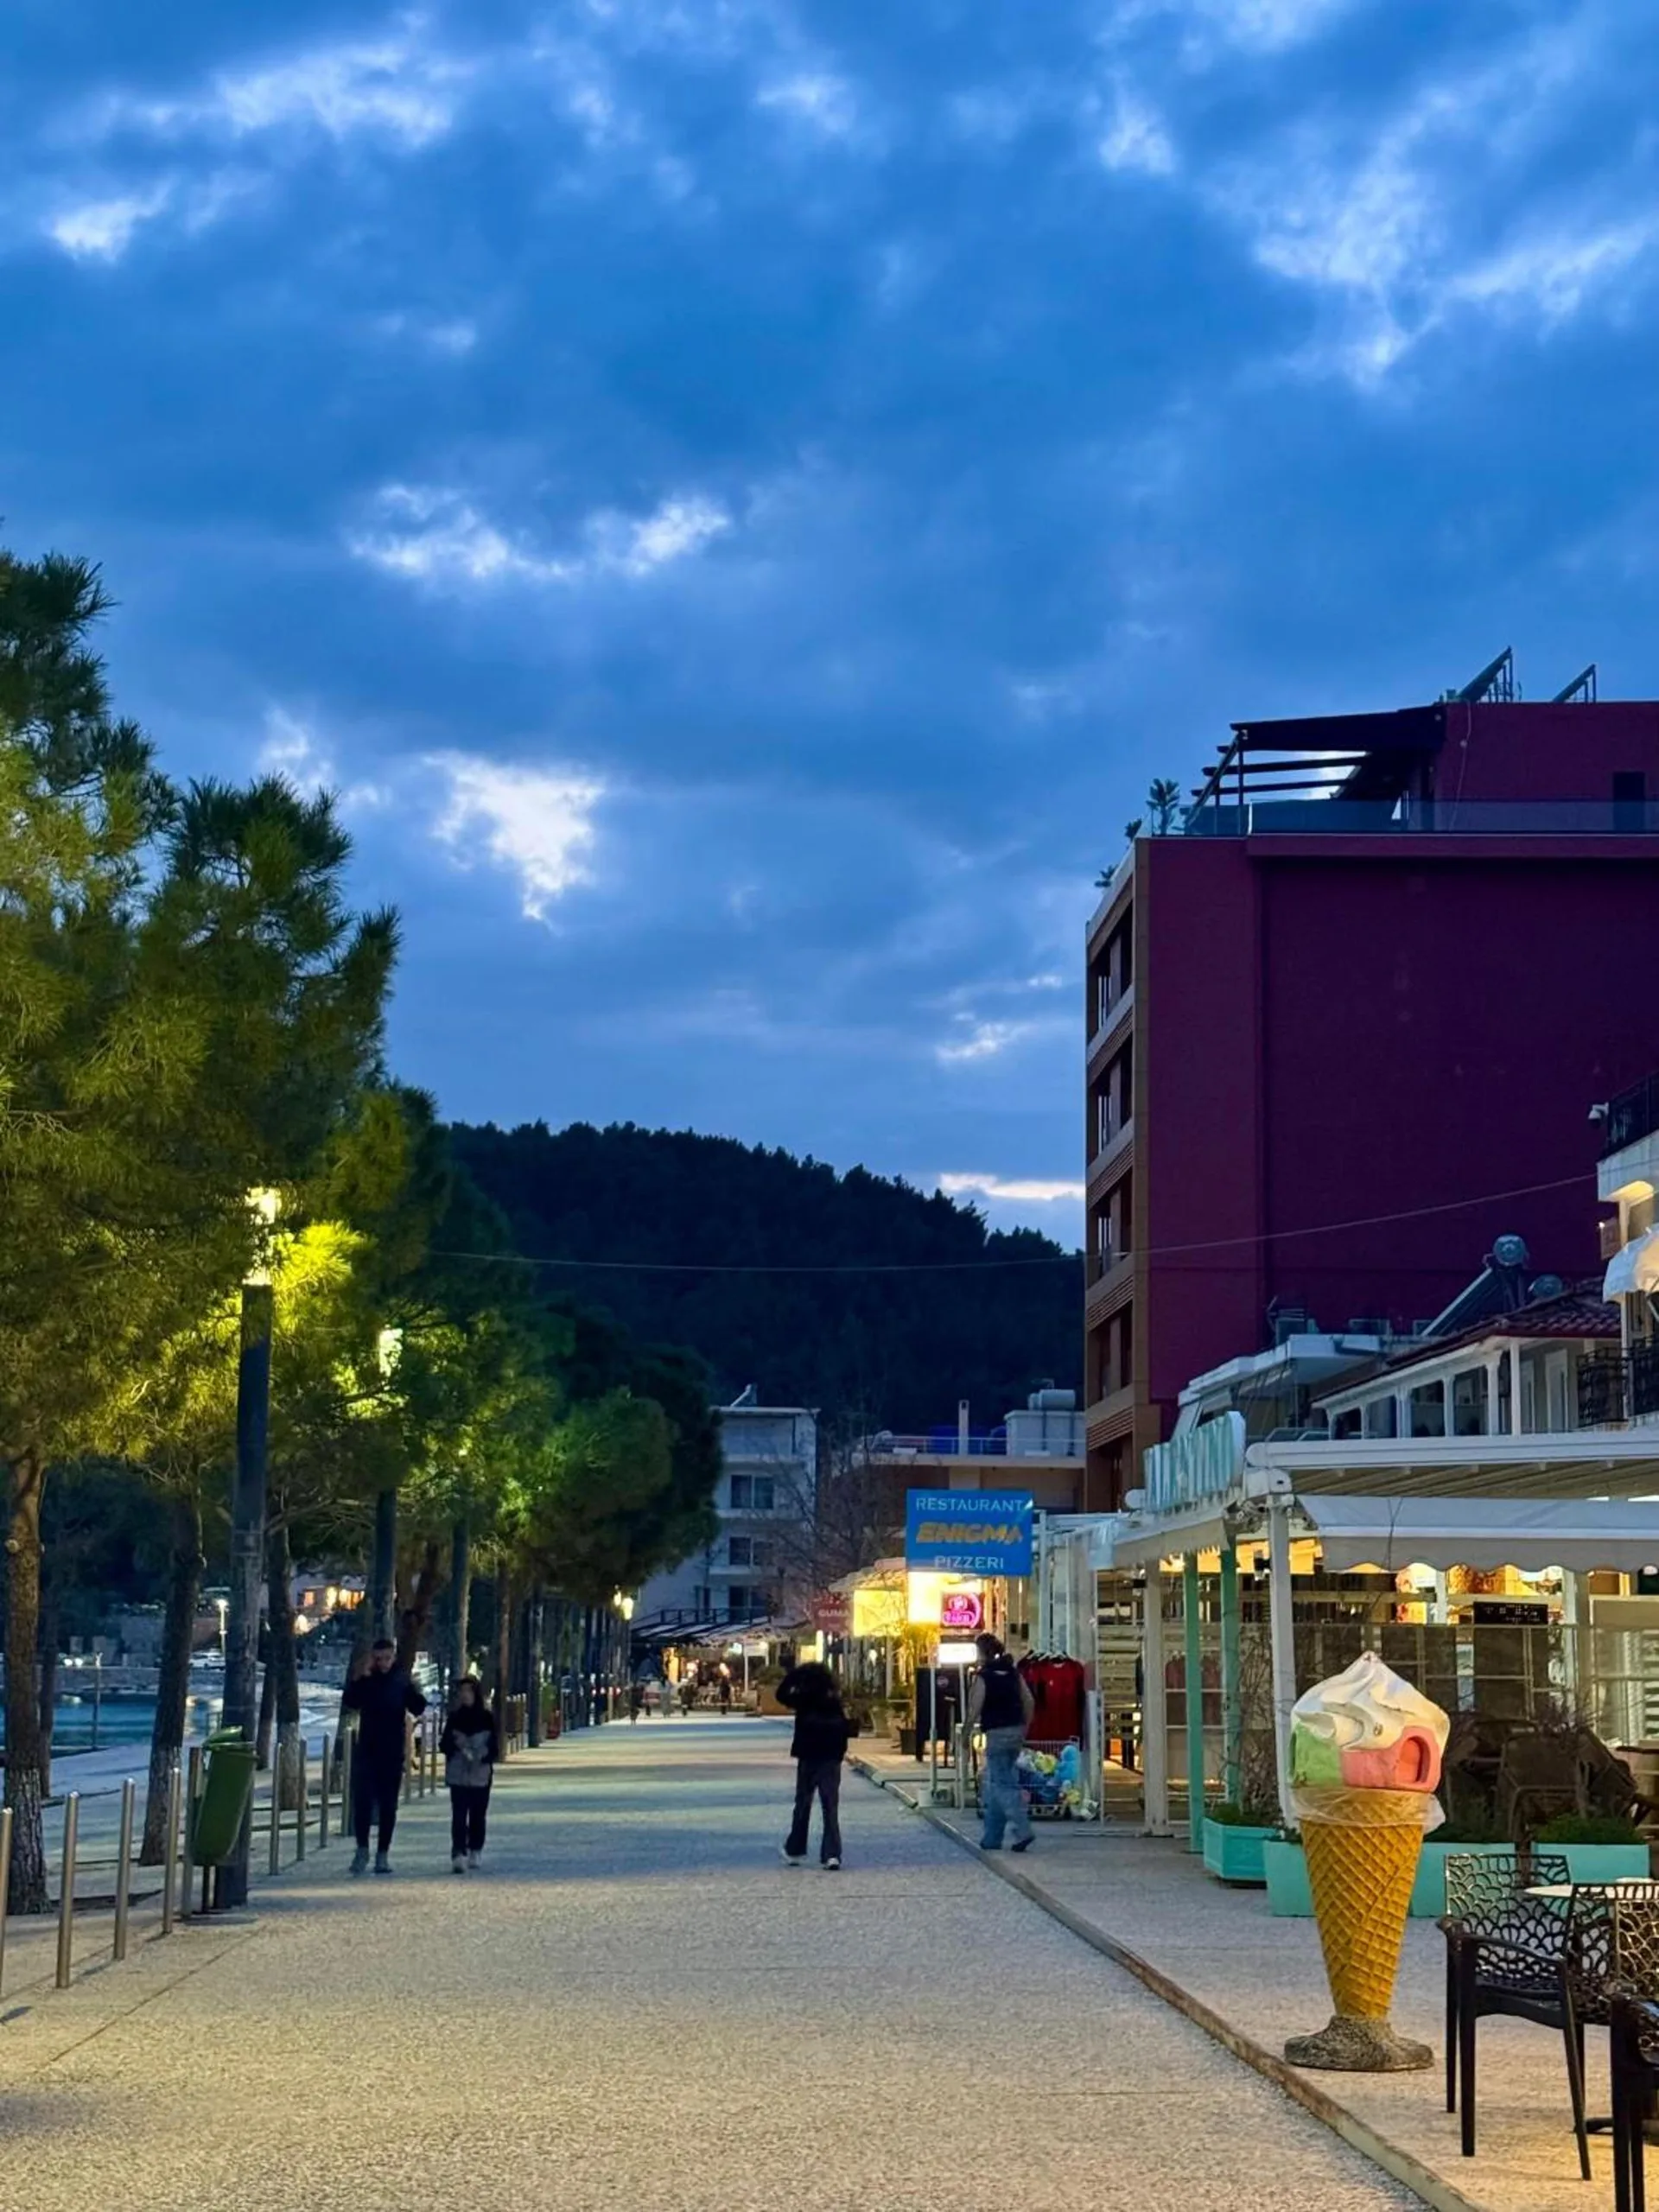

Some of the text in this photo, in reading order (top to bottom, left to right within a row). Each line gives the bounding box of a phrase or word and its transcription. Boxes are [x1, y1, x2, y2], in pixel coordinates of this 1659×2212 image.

[916, 1497, 1023, 1511] RESTAURANT
[916, 1522, 1023, 1545] ENIGMA
[934, 1556, 1004, 1569] PIZZERI
